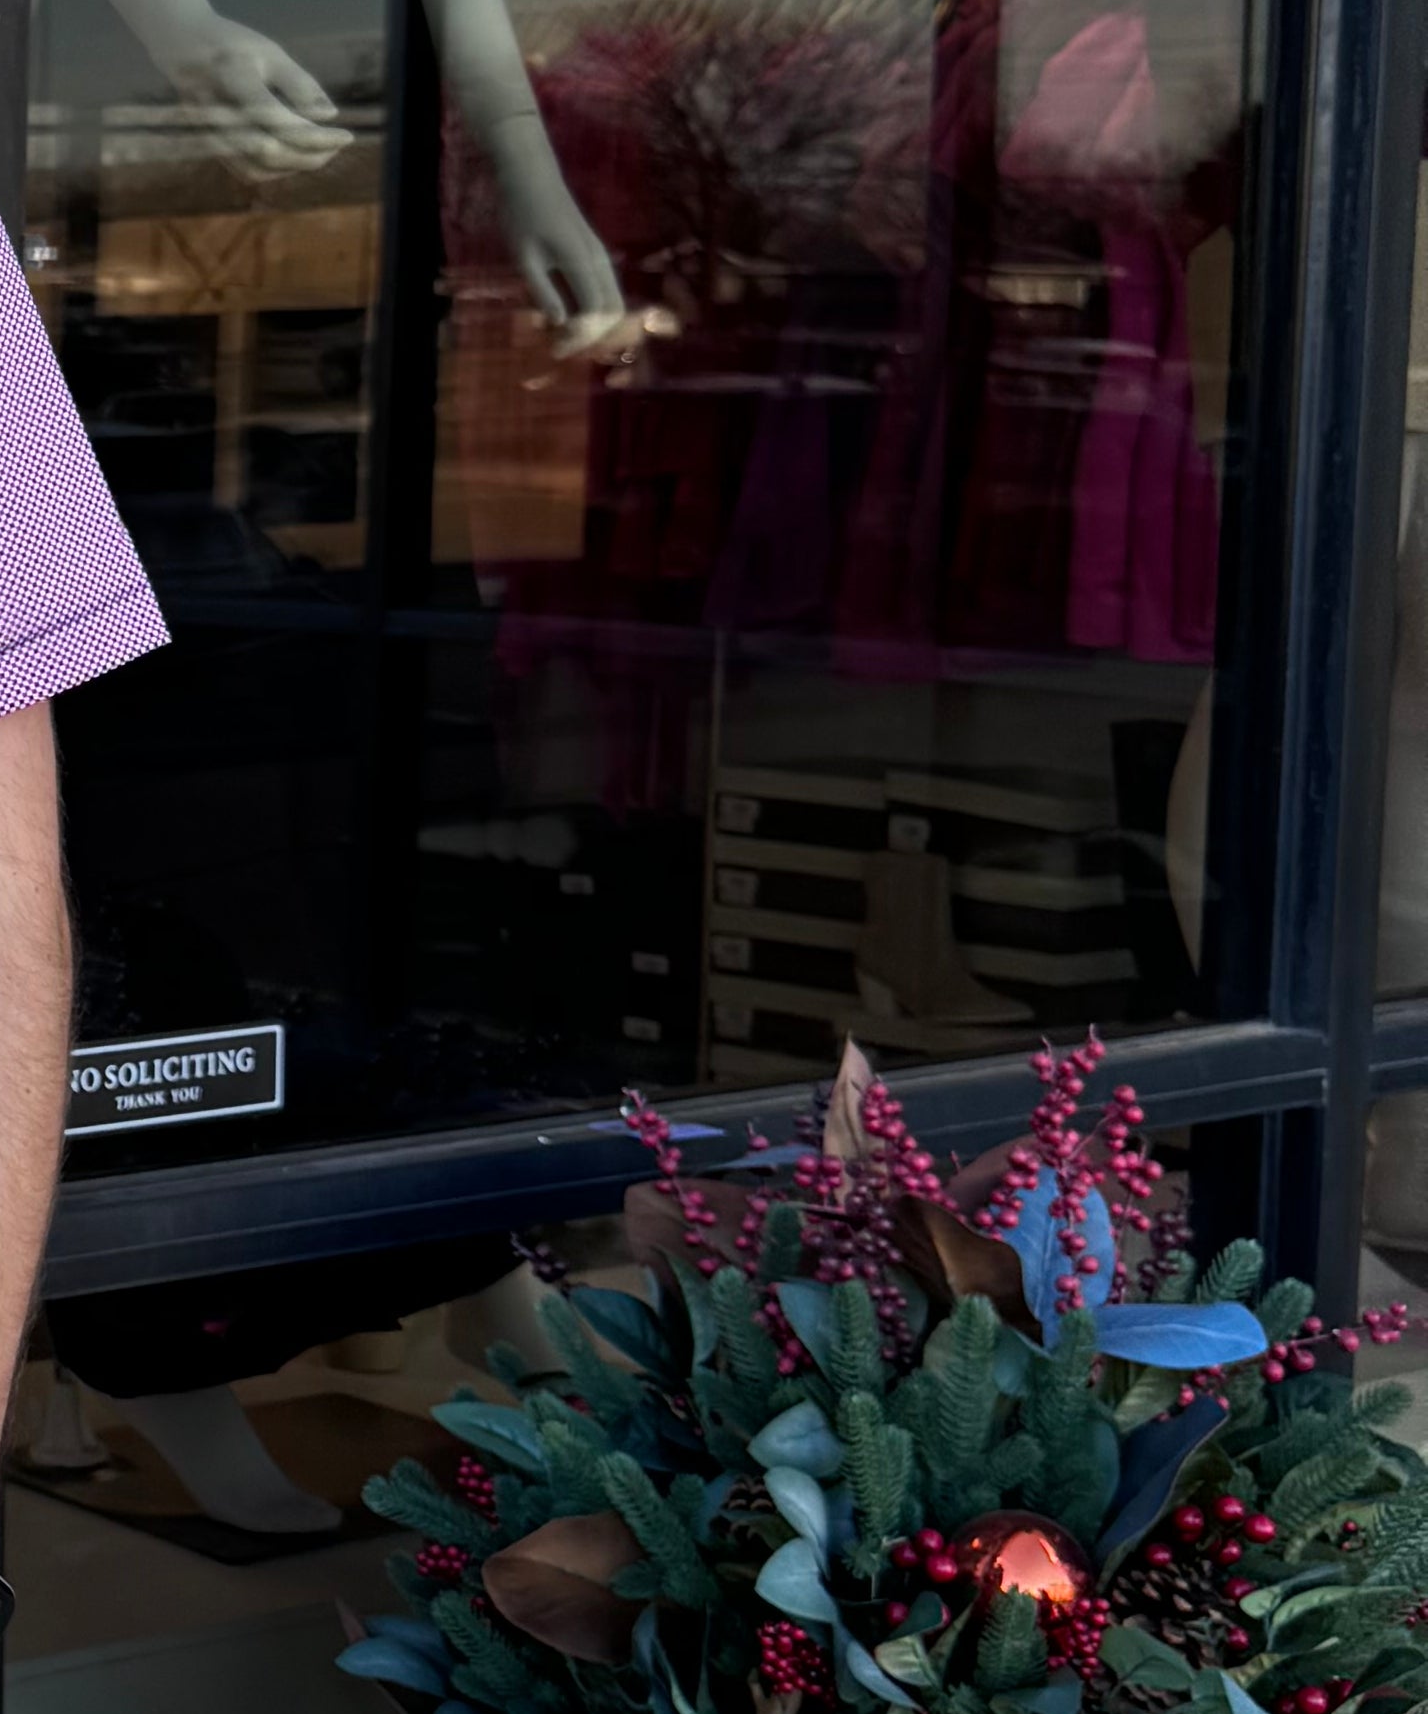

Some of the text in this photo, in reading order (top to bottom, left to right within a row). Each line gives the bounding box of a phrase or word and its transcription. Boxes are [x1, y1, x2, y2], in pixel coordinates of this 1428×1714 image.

[104, 1046, 256, 1090] SOLICITING
[115, 1085, 203, 1111] THANK YOU
